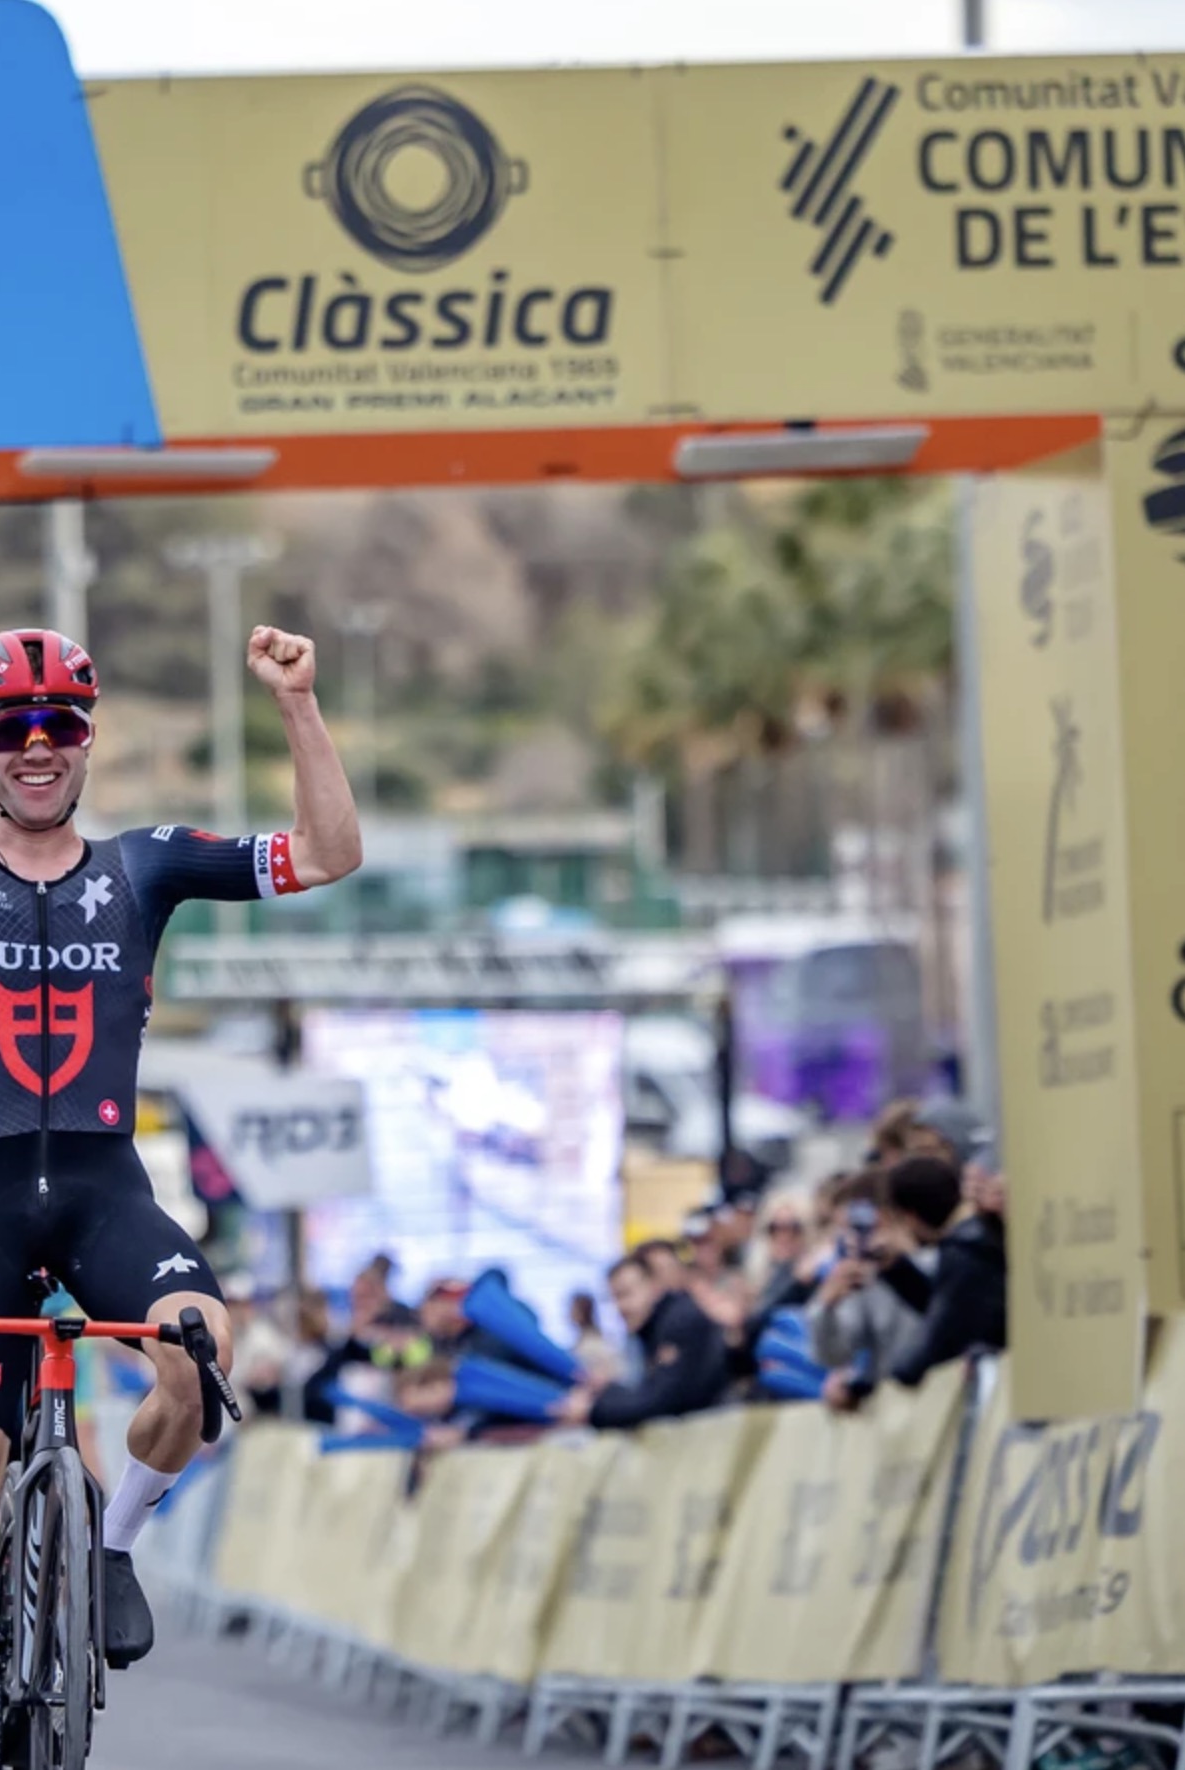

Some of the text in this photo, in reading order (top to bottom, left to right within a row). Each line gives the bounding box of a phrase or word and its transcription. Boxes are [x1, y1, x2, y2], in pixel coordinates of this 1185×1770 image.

[917, 70, 1140, 112] Comunitat
[956, 206, 1054, 270] DE
[235, 270, 613, 353] Clàssica
[233, 363, 377, 389] Comunitat
[387, 360, 537, 382] Valenciana
[238, 397, 334, 414] GRAN
[258, 839, 268, 875] BOSS
[53, 1397, 66, 1438] BMC
